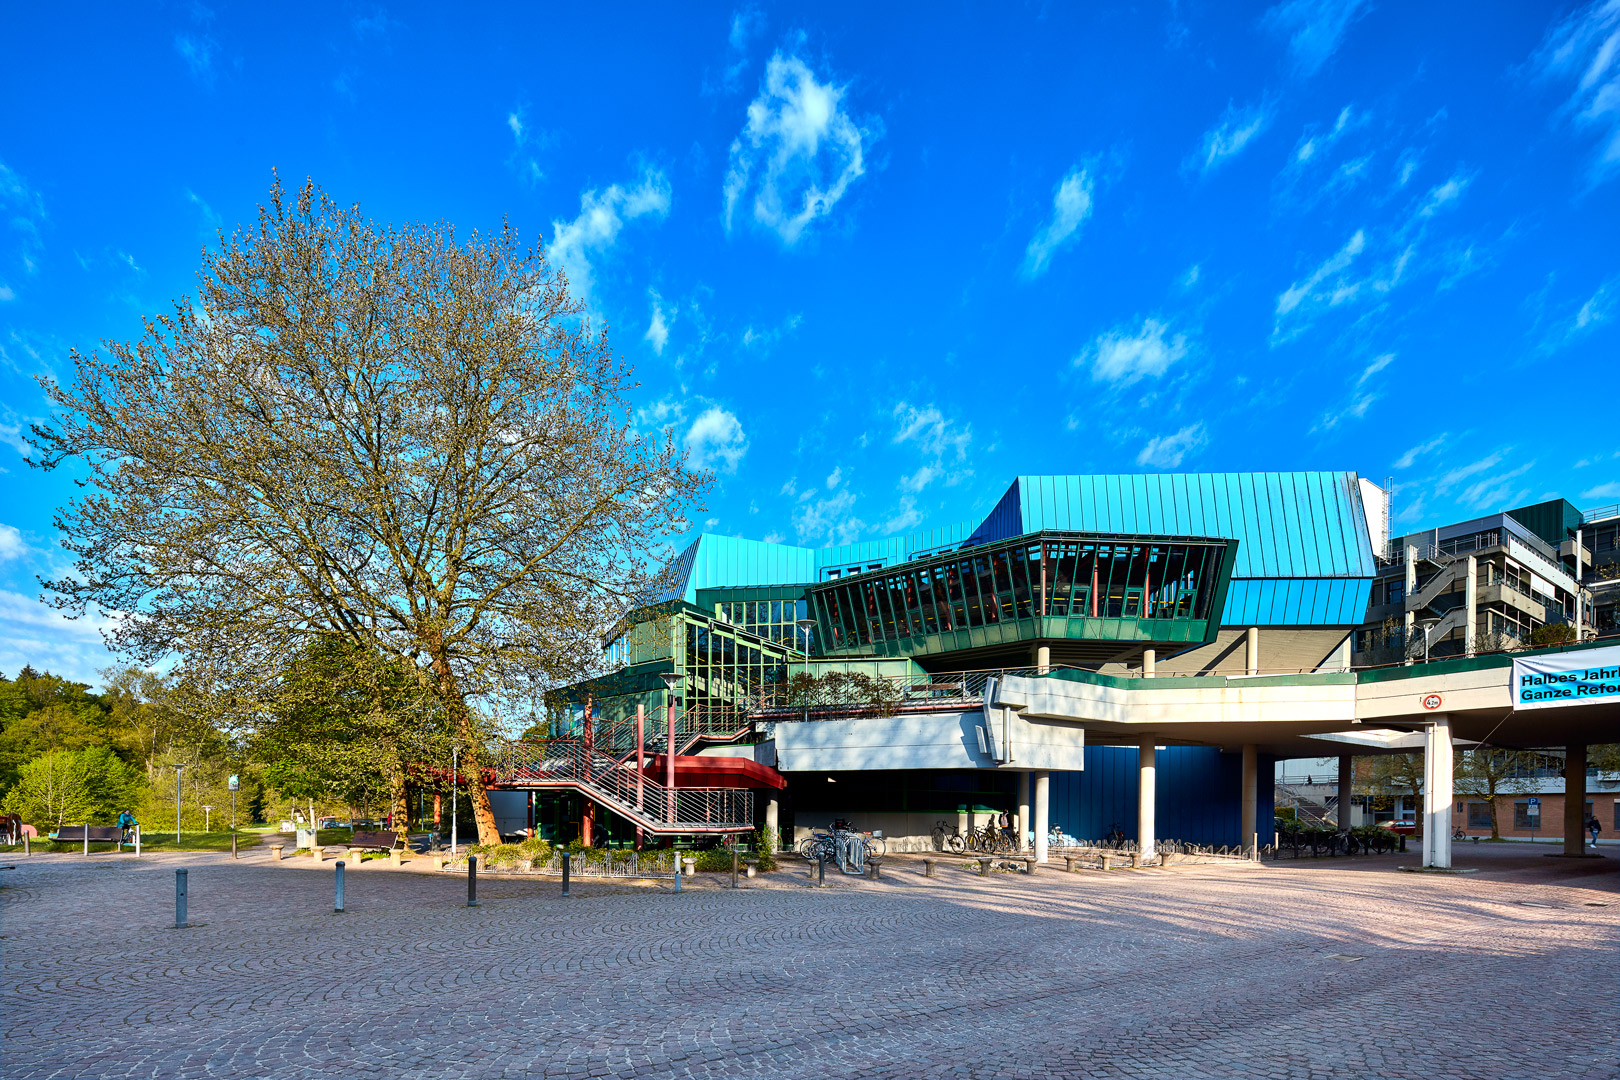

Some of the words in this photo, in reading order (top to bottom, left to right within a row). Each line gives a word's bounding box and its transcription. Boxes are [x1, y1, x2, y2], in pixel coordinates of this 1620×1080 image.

[1522, 674, 1577, 686] Halbes
[1581, 666, 1620, 681] Jahr
[1521, 688, 1572, 700] Ganze
